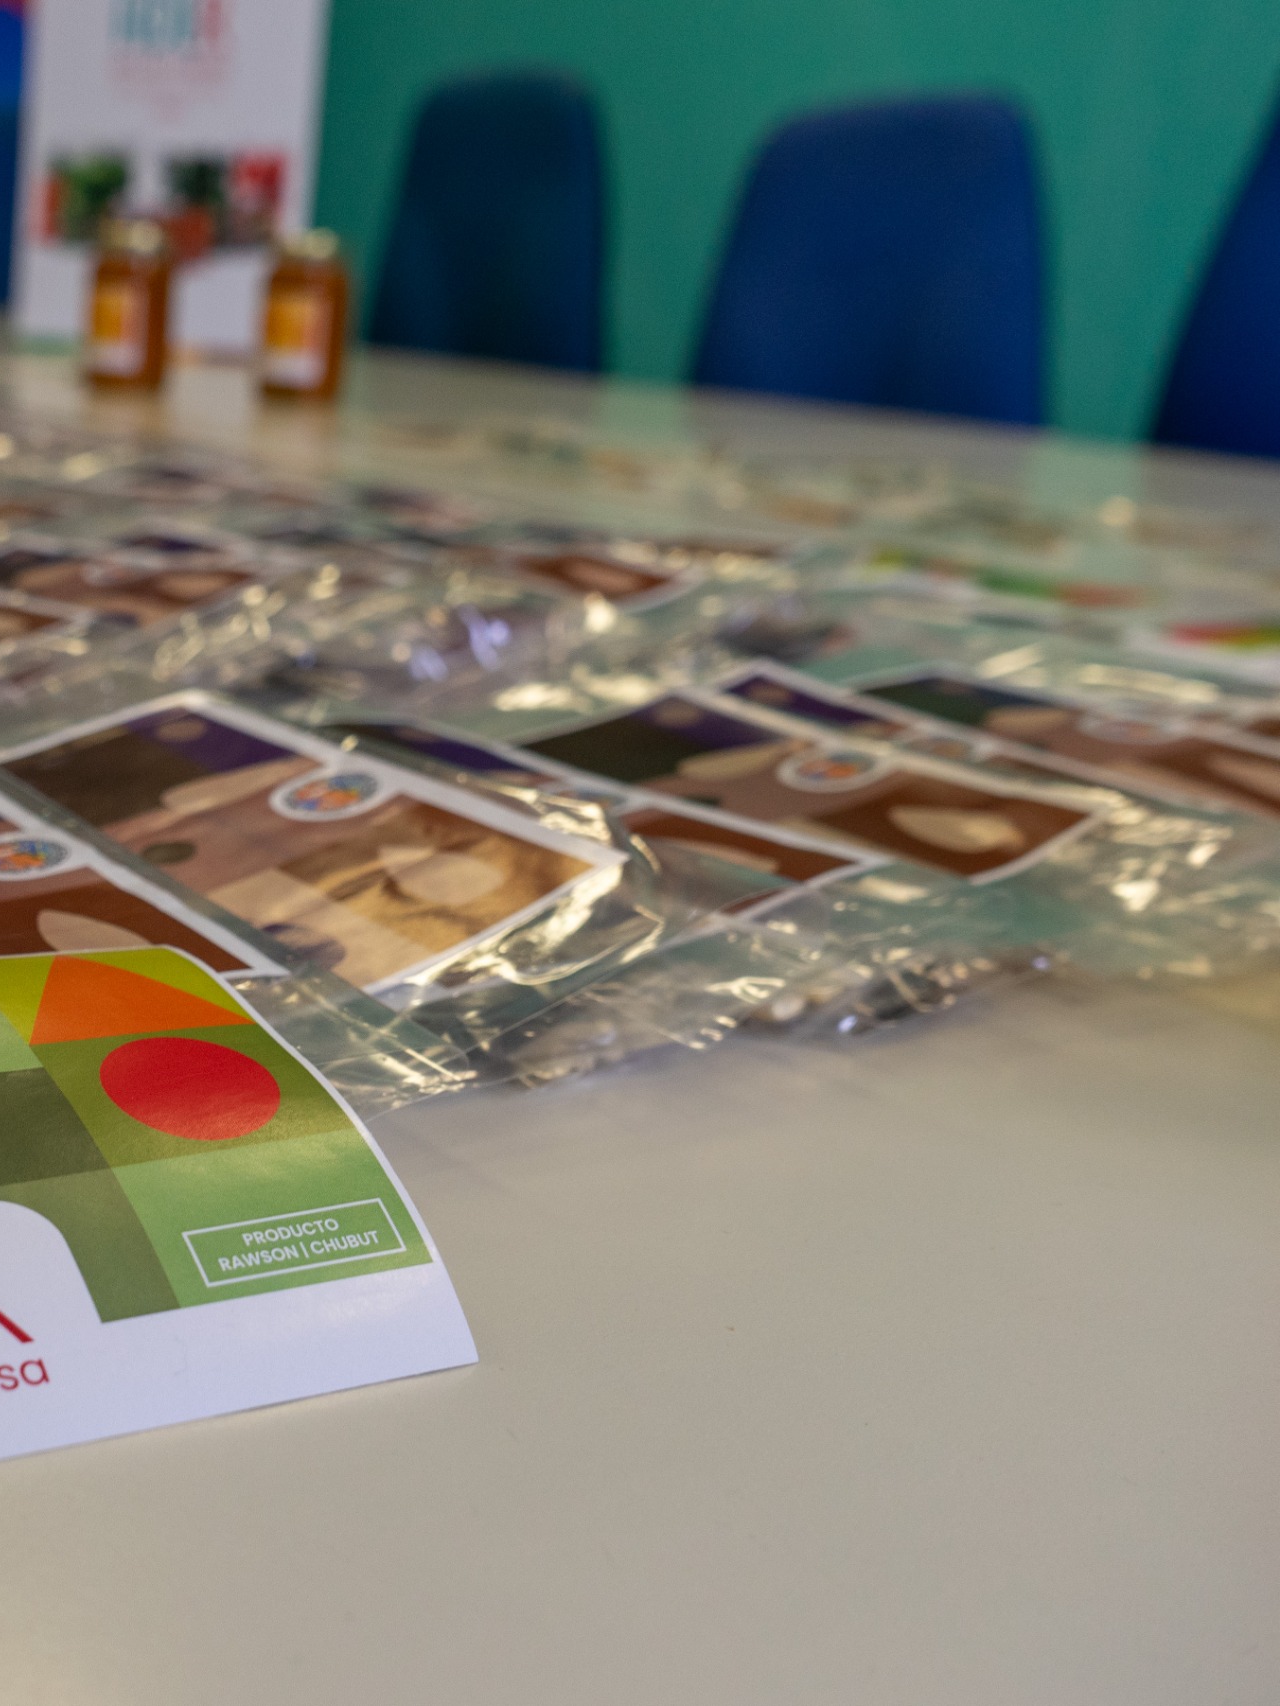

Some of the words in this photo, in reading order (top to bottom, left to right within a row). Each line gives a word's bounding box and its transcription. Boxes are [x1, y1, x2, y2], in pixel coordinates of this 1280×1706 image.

[242, 1217, 340, 1247] PRODUCTO
[218, 1244, 300, 1272] RAWSON
[310, 1230, 380, 1256] CHUBUT
